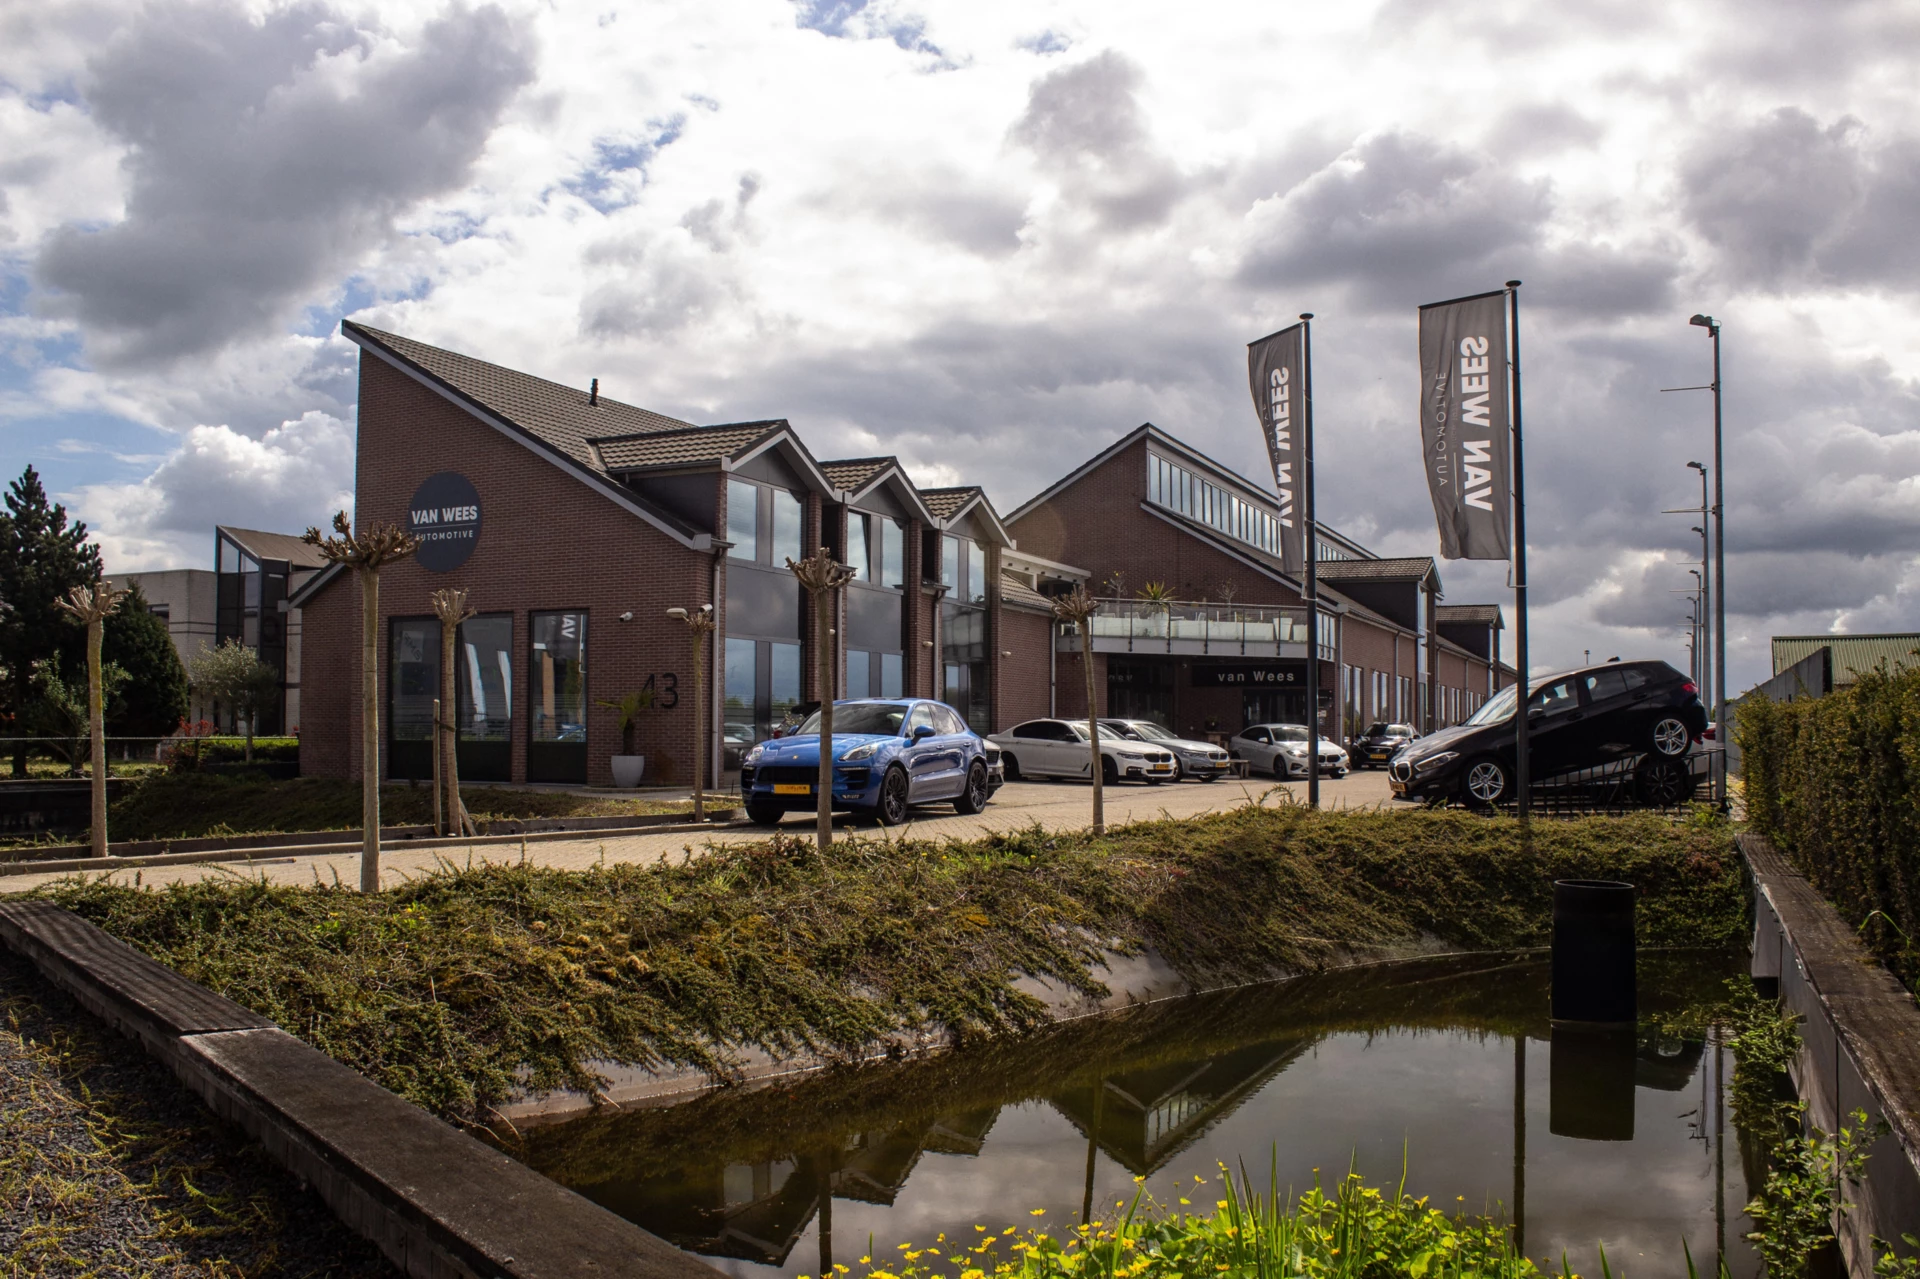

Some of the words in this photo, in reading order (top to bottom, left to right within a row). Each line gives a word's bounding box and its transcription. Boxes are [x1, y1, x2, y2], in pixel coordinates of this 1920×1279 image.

[411, 508, 438, 525] VAN
[442, 505, 478, 523] WEES
[1217, 673, 1245, 682] van
[1252, 670, 1295, 682] Wees
[638, 672, 679, 709] 43
